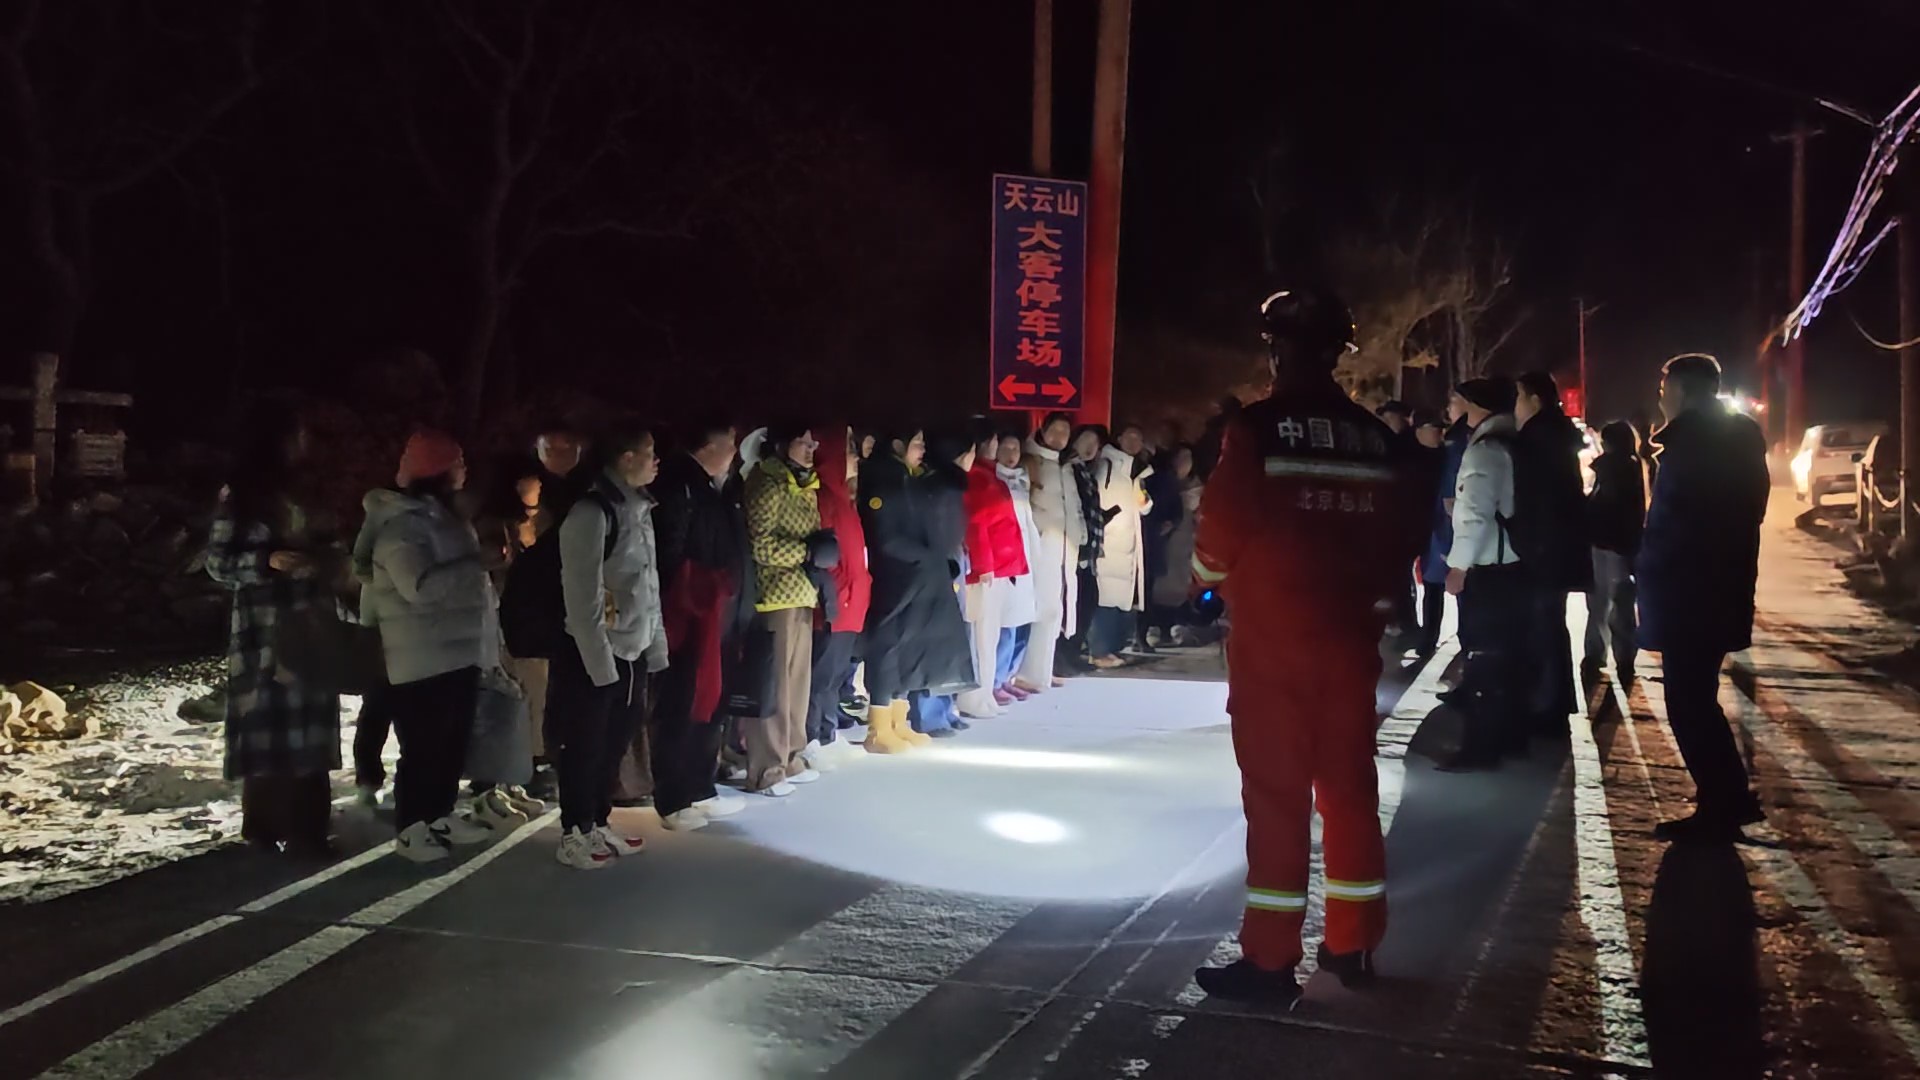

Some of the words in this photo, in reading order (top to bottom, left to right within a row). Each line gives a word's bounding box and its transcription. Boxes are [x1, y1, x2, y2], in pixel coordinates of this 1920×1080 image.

[1004, 183, 1078, 216] 天云山
[1016, 220, 1062, 367] 大客停车场
